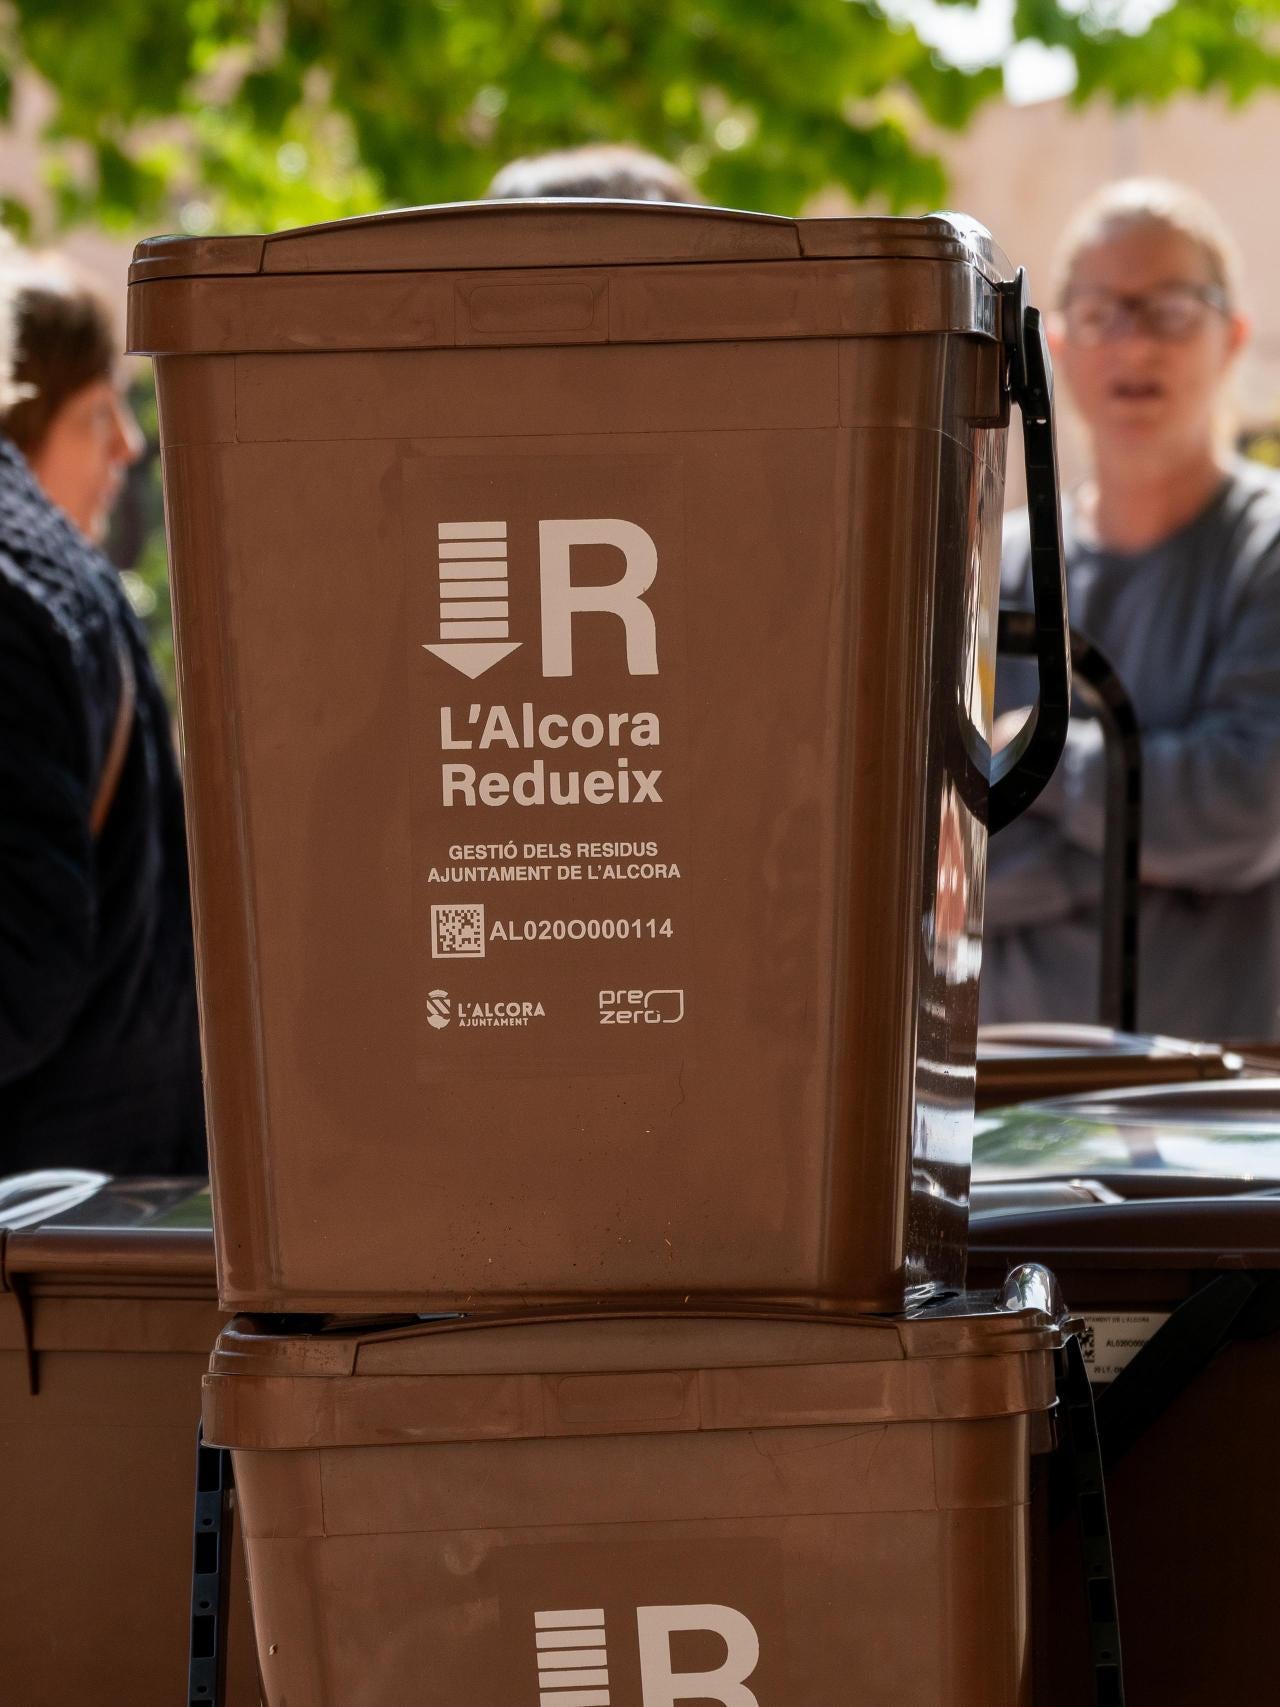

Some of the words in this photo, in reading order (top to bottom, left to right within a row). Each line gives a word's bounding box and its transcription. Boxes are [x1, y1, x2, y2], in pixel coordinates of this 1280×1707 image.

[538, 518, 659, 678] R
[440, 702, 660, 750] L'Alcora
[442, 757, 663, 807] Redueix
[448, 840, 518, 860] GESTIÓ
[523, 843, 571, 859] DELS
[577, 842, 658, 858] RESIDUS
[427, 866, 552, 883] AJUNTAMENT
[557, 865, 582, 880] DE
[587, 863, 681, 880] L'ALCORA
[599, 990, 644, 1009] pre
[458, 1002, 545, 1018] L'ALCORA
[599, 1010, 661, 1024] zero
[459, 1017, 529, 1027] AJUNTAMENT
